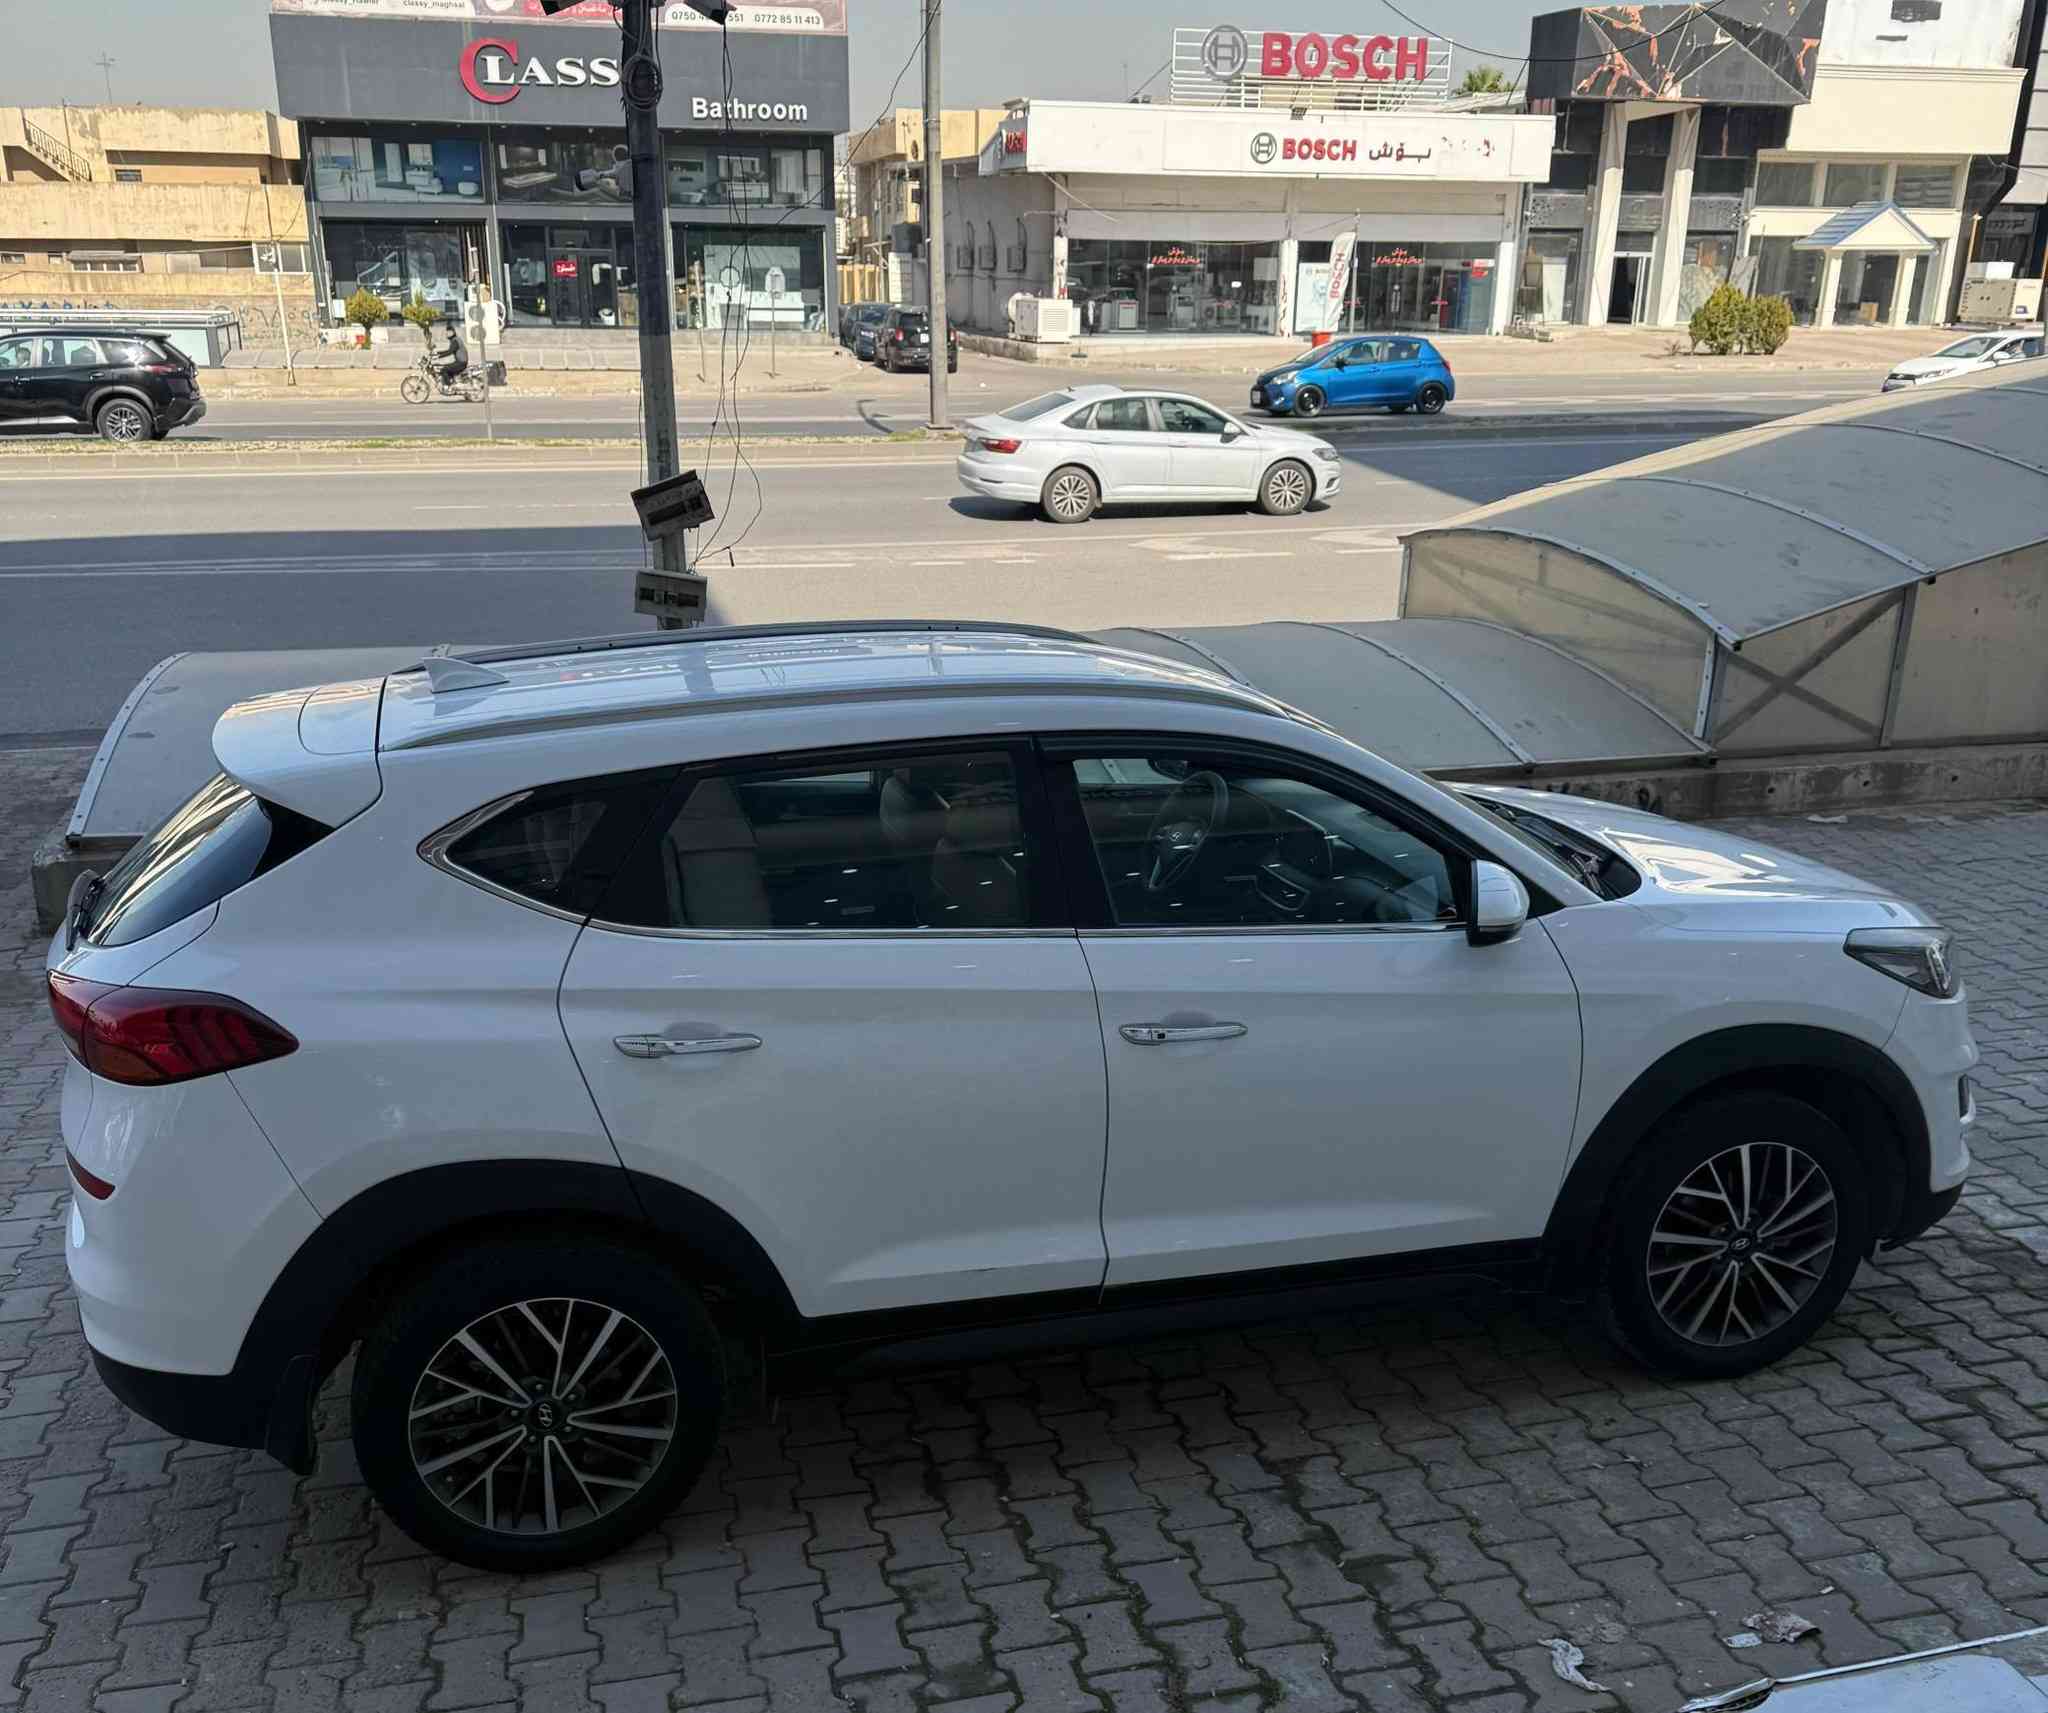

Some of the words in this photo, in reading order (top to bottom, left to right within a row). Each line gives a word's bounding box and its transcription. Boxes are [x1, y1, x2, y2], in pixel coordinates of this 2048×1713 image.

[671, 11, 696, 21] 0750
[754, 14, 778, 24] 0772
[780, 15, 792, 24] 85
[794, 15, 802, 24] 11
[1261, 32, 1428, 81] BOSCH
[459, 37, 621, 105] CLASS
[691, 97, 808, 121] Bathroom
[1282, 137, 1358, 161] BOSCH
[1329, 252, 1346, 299] BOSCH
